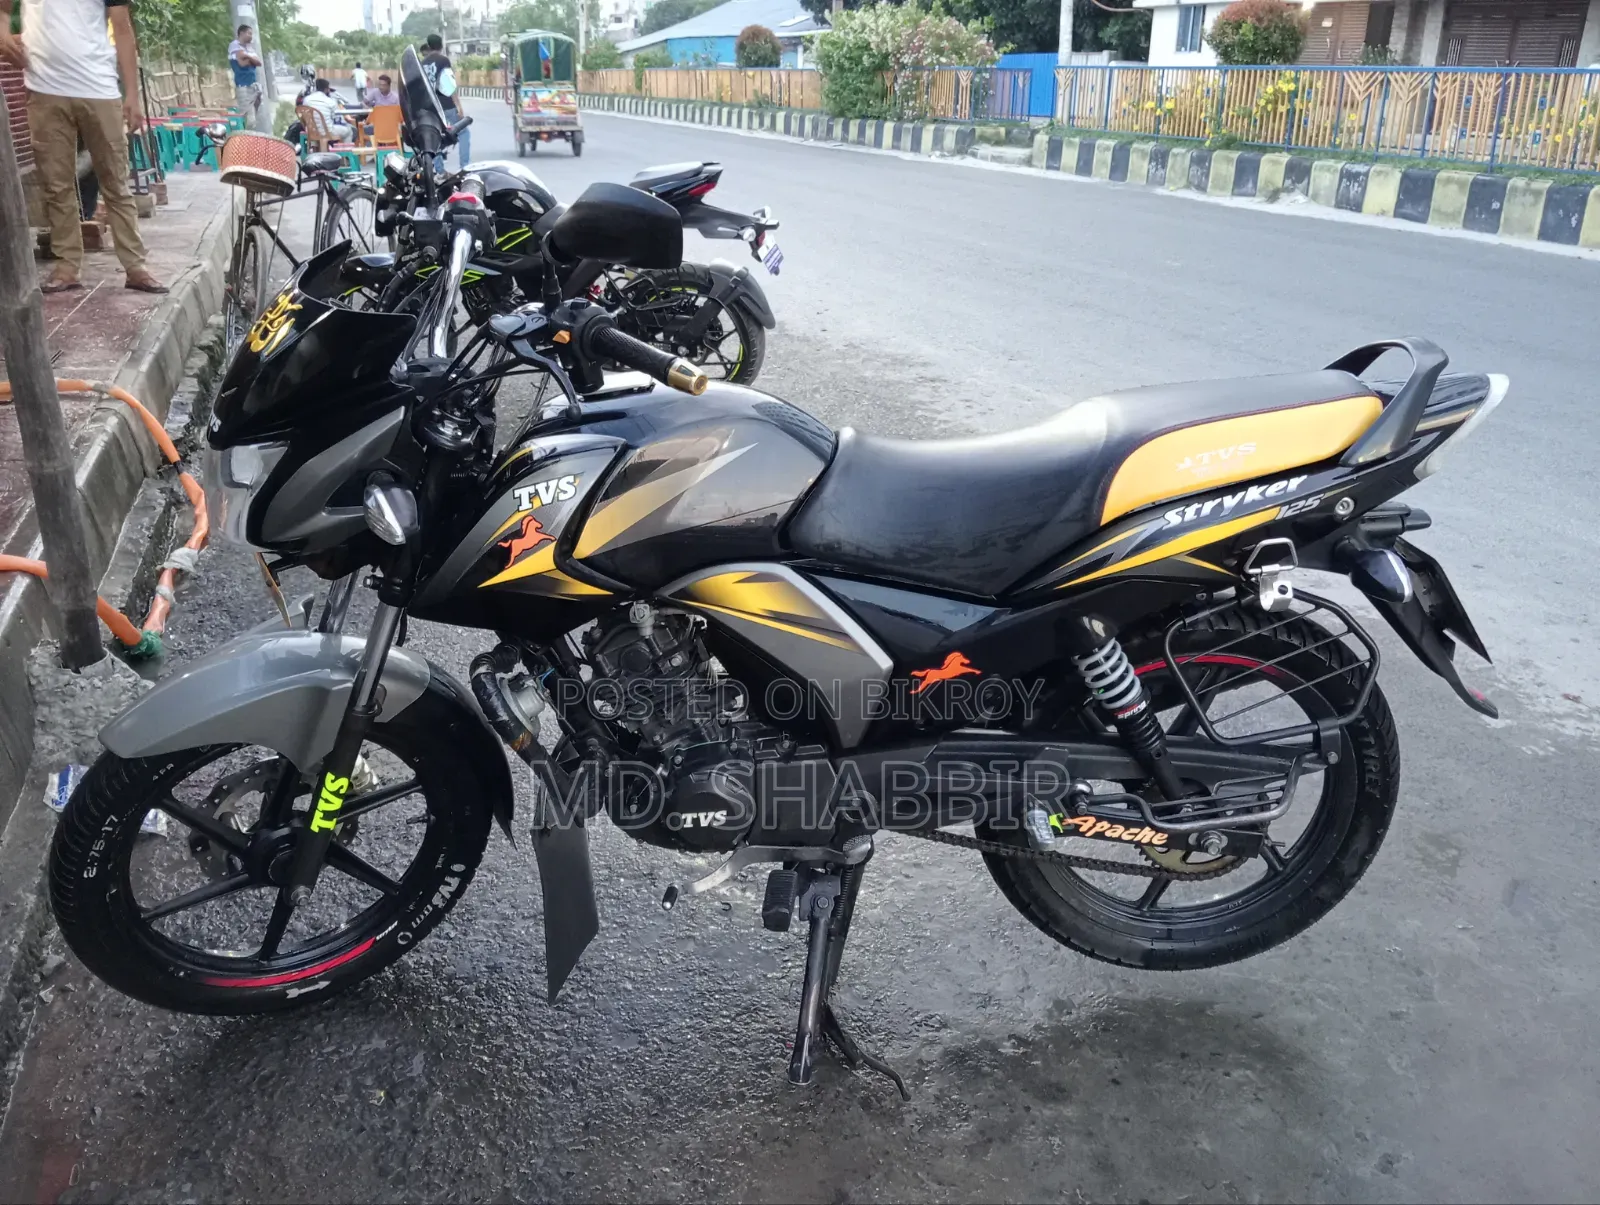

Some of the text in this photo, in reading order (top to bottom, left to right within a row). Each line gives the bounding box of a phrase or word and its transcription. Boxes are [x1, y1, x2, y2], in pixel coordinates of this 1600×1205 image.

[1195, 442, 1257, 465] TVS
[513, 475, 577, 512] TVS
[1162, 475, 1325, 531] Stryker 125
[310, 771, 349, 833] TVS
[681, 809, 728, 828] TVS
[1062, 815, 1169, 846] Apache
